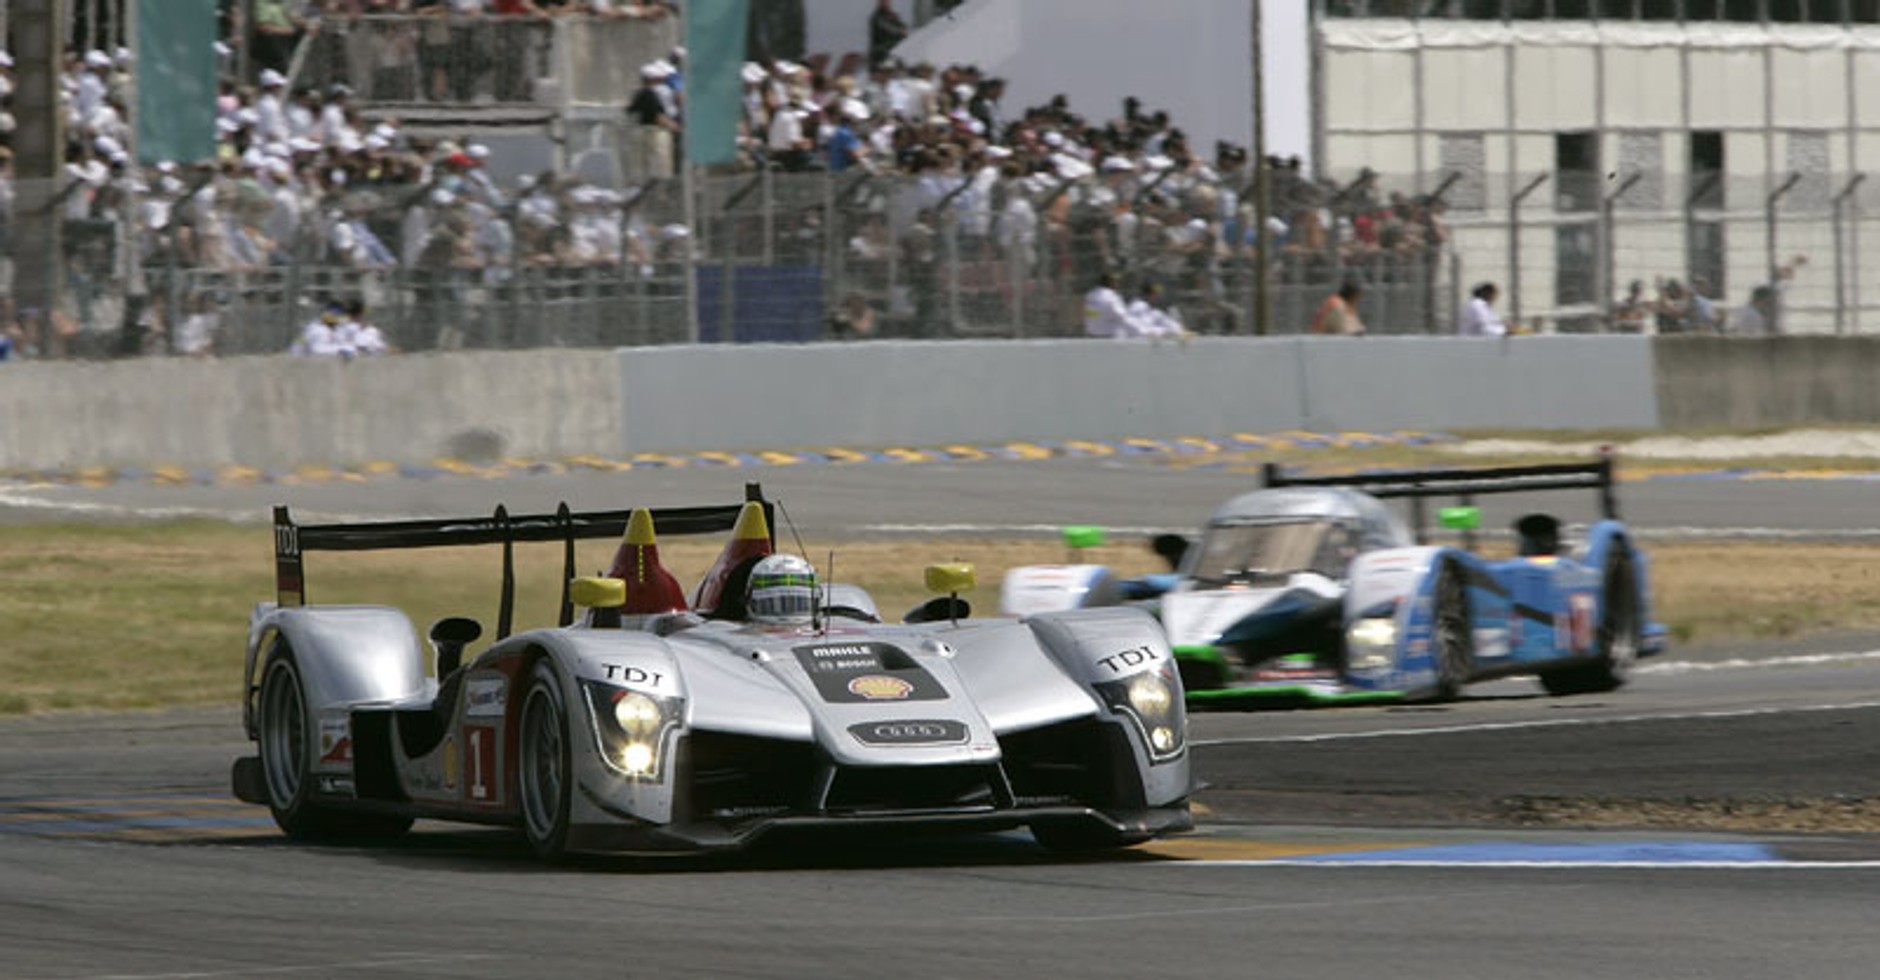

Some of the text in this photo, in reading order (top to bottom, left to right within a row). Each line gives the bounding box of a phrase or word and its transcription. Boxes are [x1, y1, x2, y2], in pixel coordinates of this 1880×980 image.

[275, 524, 299, 555] TDI
[813, 646, 872, 657] MAHLE
[1097, 645, 1160, 673] TDI
[601, 662, 664, 688] TDI
[470, 730, 487, 798] 1
